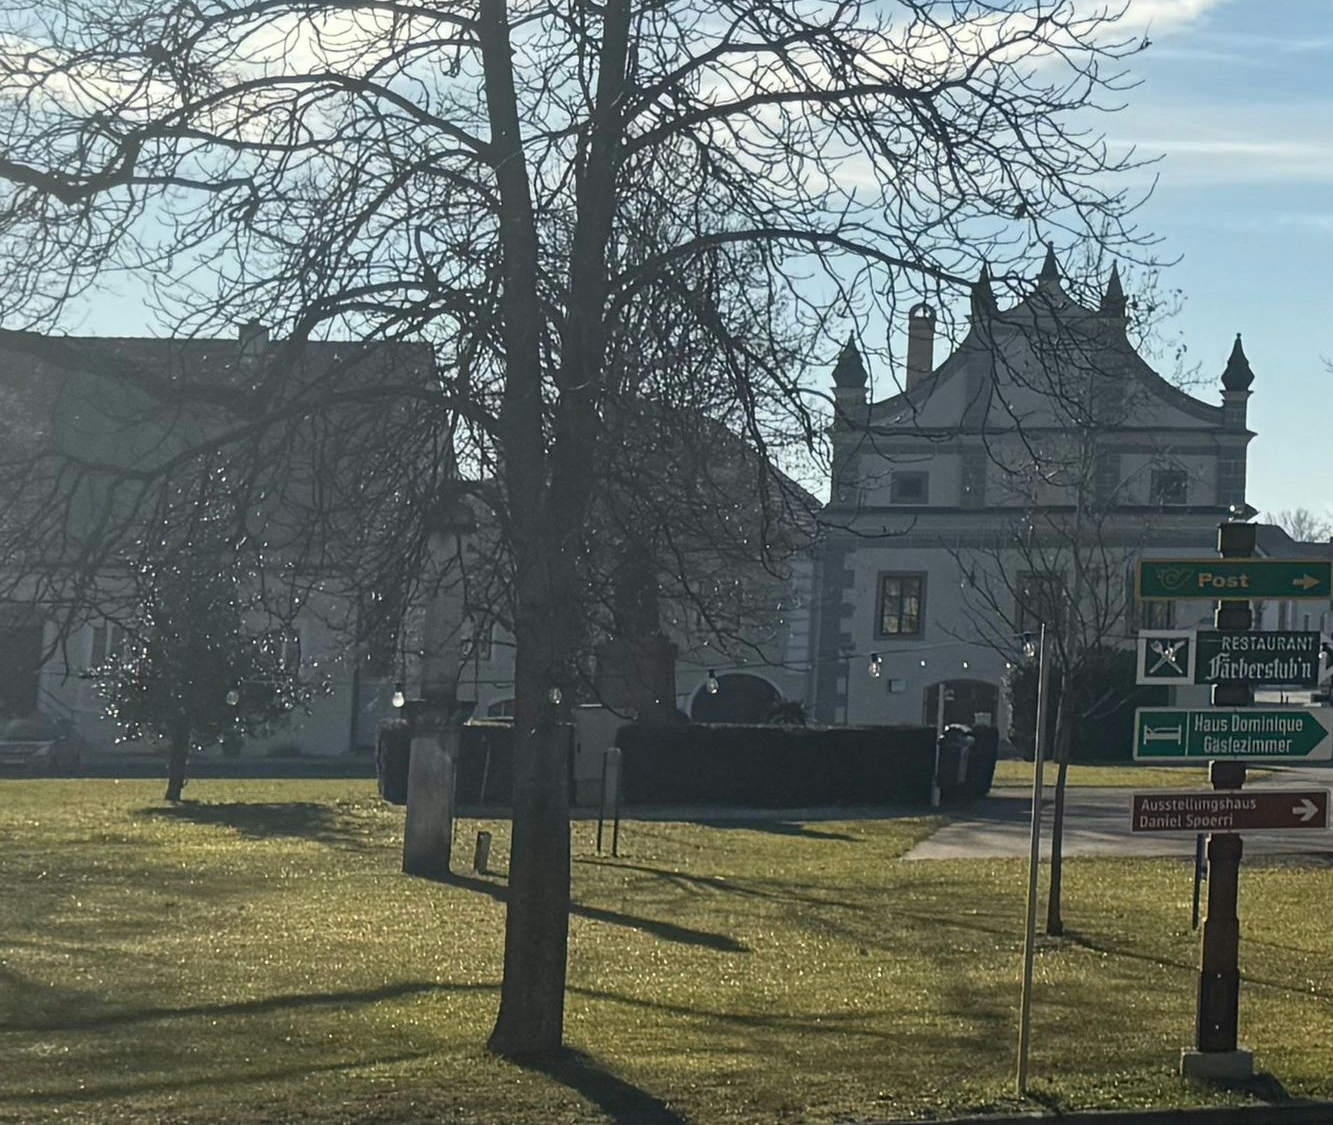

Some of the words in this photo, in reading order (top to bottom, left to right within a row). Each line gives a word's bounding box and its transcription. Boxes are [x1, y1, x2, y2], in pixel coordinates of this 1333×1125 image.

[1198, 573, 1249, 588] Post
[1221, 636, 1314, 651] RESTAURANT
[1194, 715, 1228, 732] Haus
[1231, 715, 1303, 735] Dominique
[1204, 736, 1292, 753] Gästezimmer
[1141, 797, 1257, 813] Ausstellungshaus
[1140, 814, 1182, 828] Daniel
[1186, 813, 1233, 829] Spoerri
